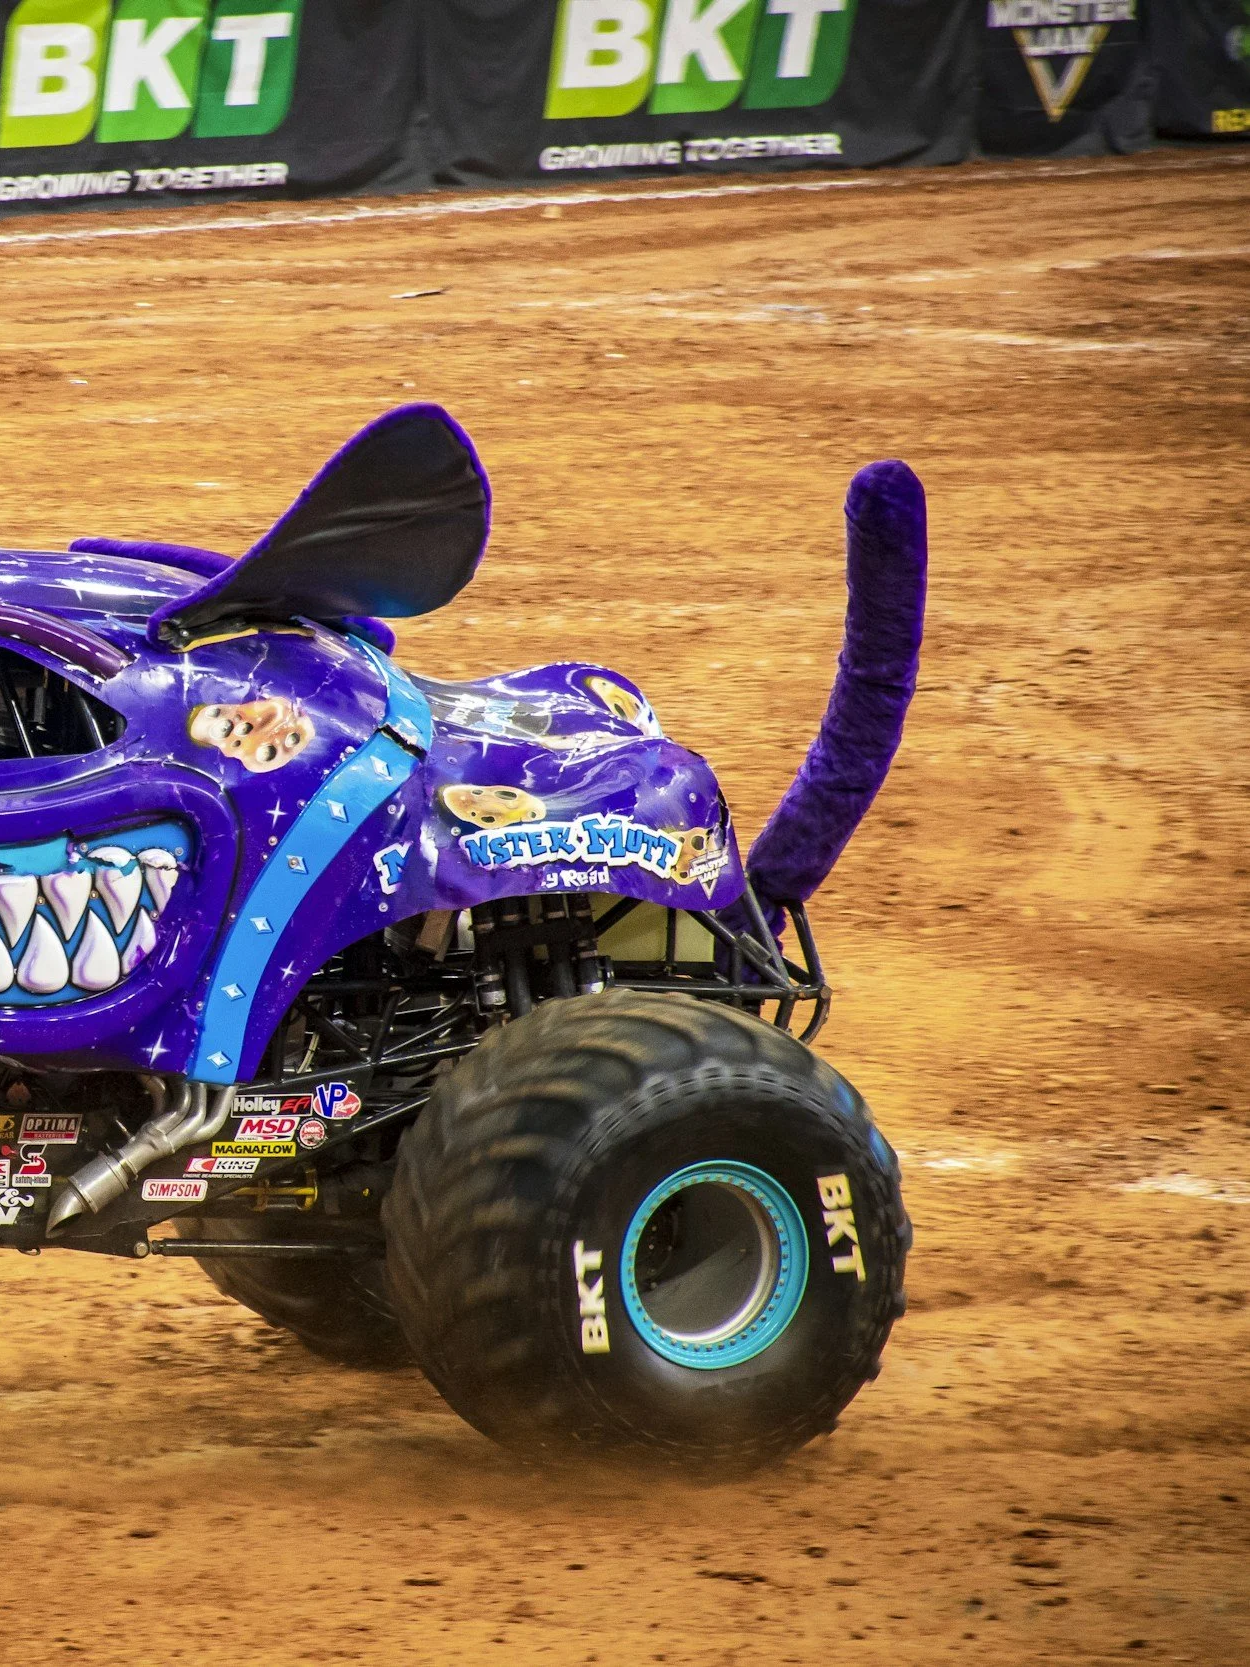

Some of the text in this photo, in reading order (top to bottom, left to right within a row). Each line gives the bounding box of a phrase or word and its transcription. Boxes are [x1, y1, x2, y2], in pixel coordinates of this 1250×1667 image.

[559, 0, 843, 89] BKT
[8, 13, 294, 117] BKT
[540, 134, 841, 170] GROWING TOGETHER
[135, 163, 288, 192] TOGETHER
[233, 1096, 281, 1115] Holley
[317, 1083, 348, 1118] VP
[26, 1118, 76, 1131] OPTIMA
[241, 1119, 296, 1134] MSD
[215, 1145, 292, 1154] MAGNAFLOW
[216, 1161, 256, 1170] KING
[148, 1183, 202, 1197] SIMPSON
[817, 1173, 866, 1283] BKT
[573, 1239, 610, 1355] BKT
